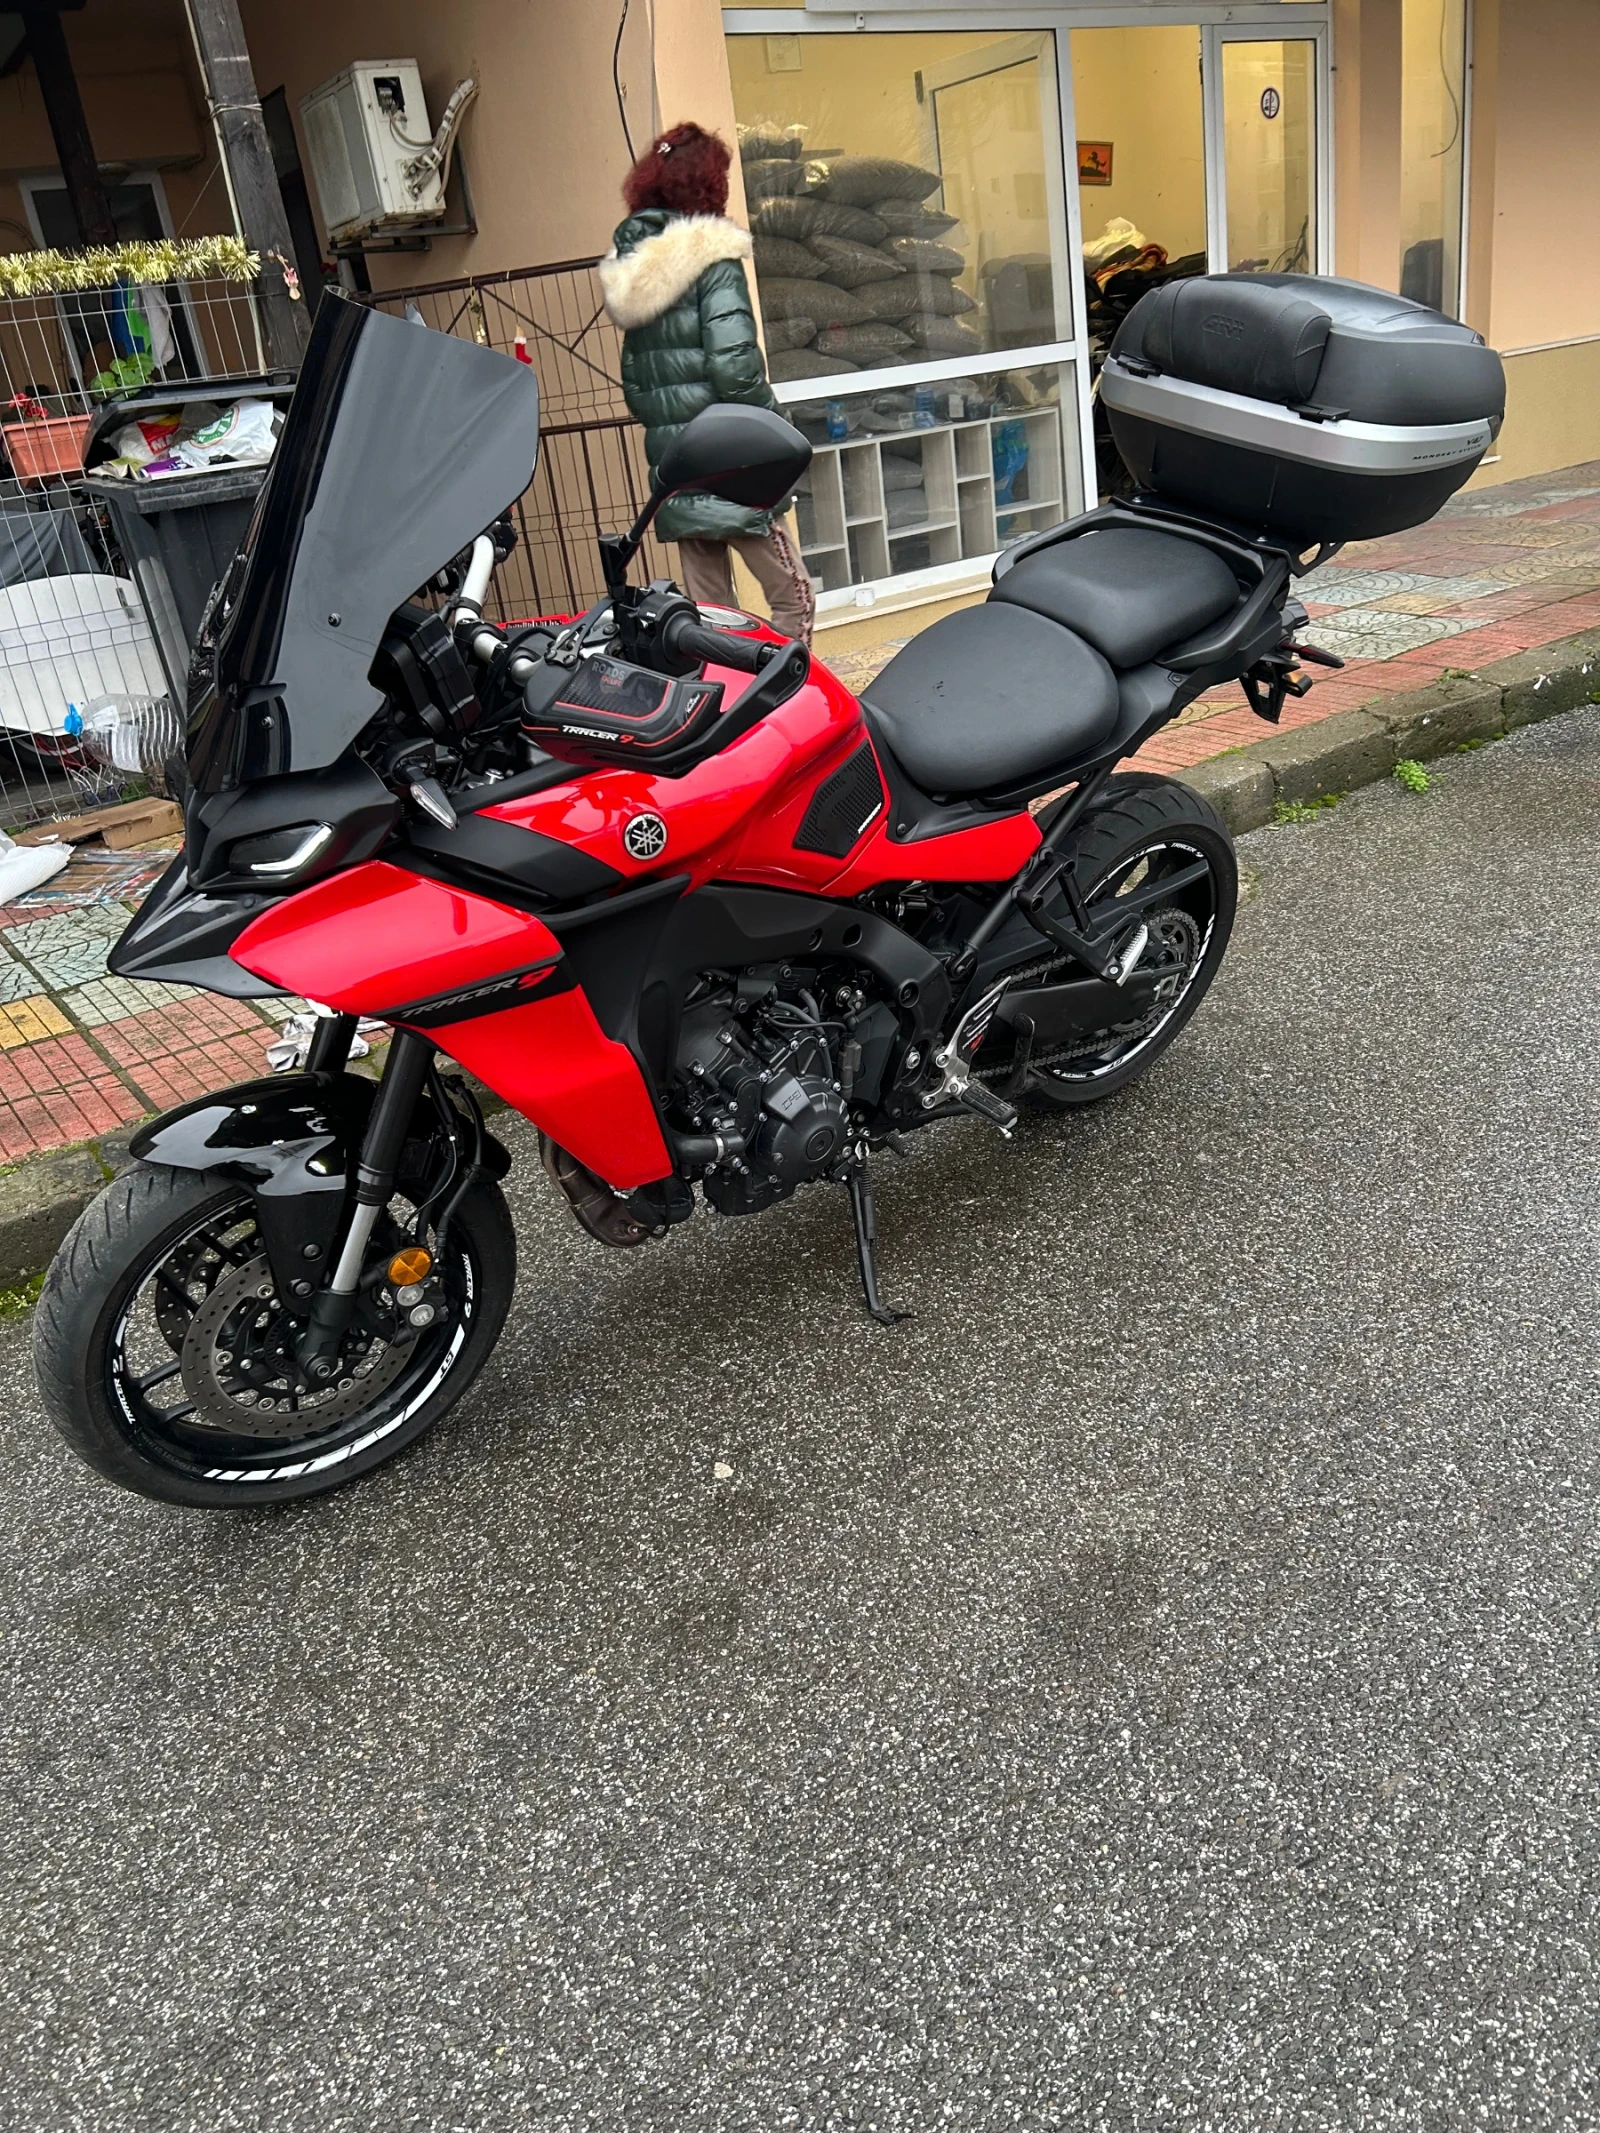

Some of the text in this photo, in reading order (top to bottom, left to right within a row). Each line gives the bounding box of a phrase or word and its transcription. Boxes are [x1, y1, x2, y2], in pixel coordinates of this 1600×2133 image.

[1412, 450, 1457, 461] MONOKEY
[591, 660, 626, 681] ROADS
[562, 724, 635, 744] TRACER 9
[401, 965, 558, 1019] TRACER 9
[461, 1252, 474, 1301] TRACER
[113, 1377, 136, 1425] TRACER
